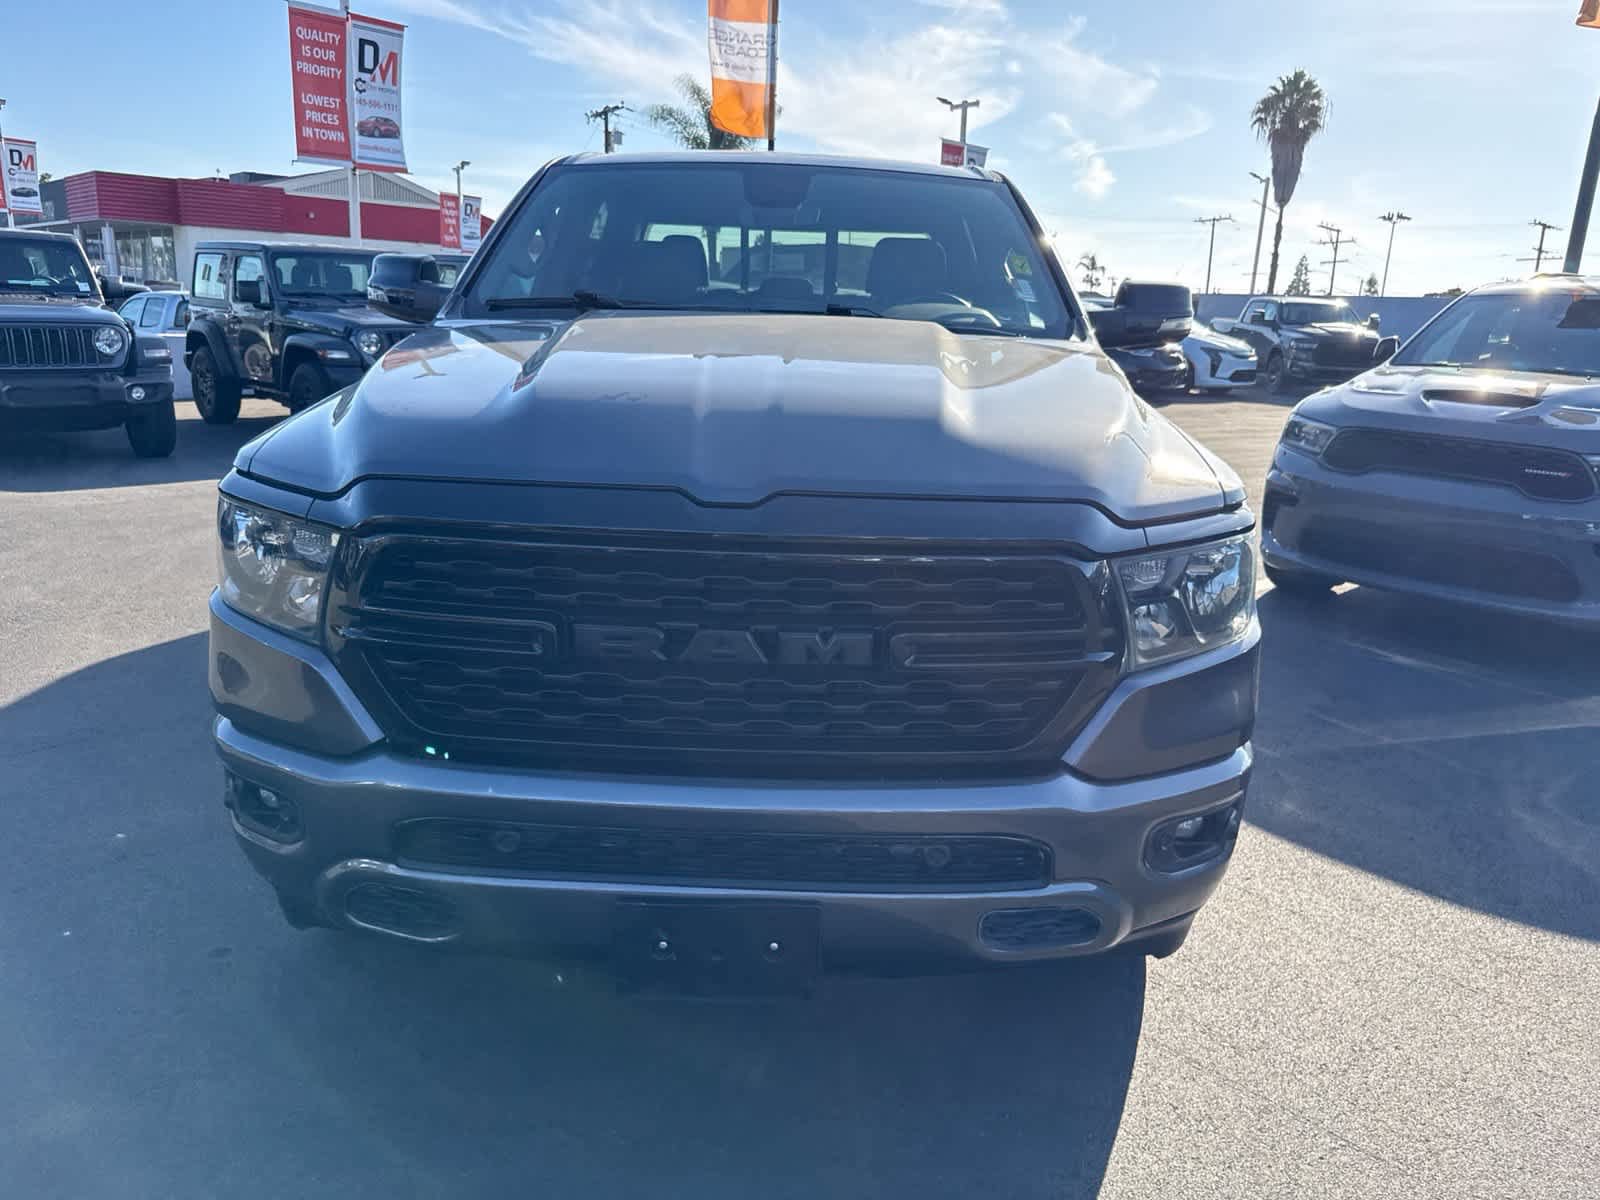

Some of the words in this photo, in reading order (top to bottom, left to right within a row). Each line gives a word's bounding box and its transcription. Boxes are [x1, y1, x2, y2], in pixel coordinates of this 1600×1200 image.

[295, 26, 341, 46] QUALITY
[302, 46, 312, 58] IS
[313, 47, 336, 62] OUR
[296, 60, 343, 79] PRIORITY
[301, 92, 340, 110] LOWEST
[305, 110, 339, 125] PRICES
[302, 127, 313, 138] IN
[315, 128, 345, 142] TOWN
[574, 622, 873, 665] RAM
